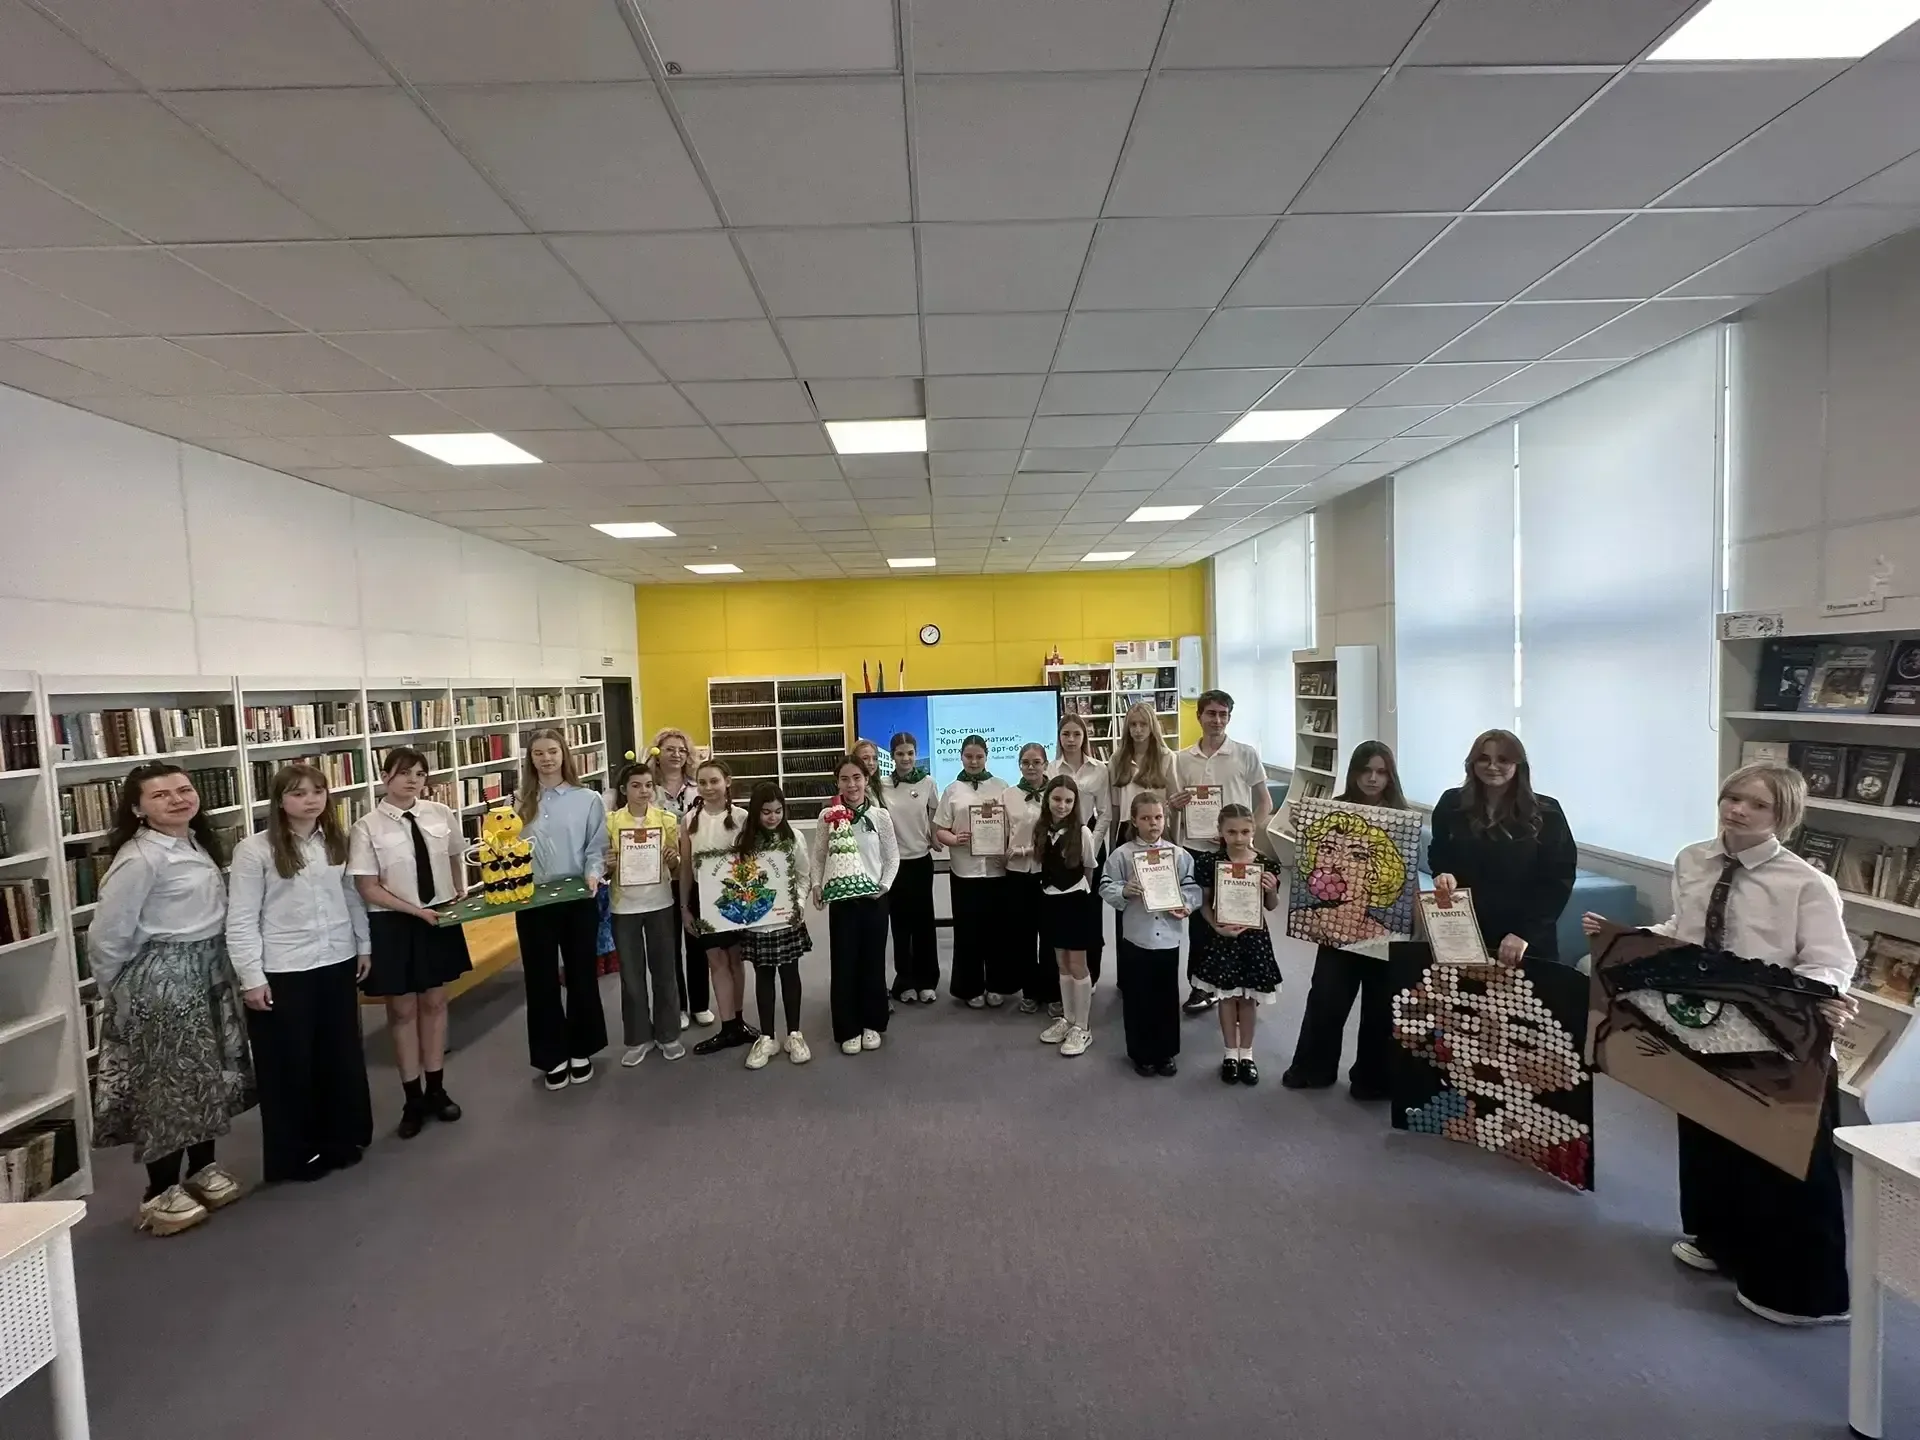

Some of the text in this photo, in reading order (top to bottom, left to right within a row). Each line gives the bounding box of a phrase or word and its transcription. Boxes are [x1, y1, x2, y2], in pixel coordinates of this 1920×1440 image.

[454, 717, 460, 725] Р
[292, 729, 301, 739] И
[327, 726, 335, 736] К
[246, 731, 256, 742] Ж
[263, 733, 271, 742] З
[1142, 865, 1170, 873] ГРАМОТА
